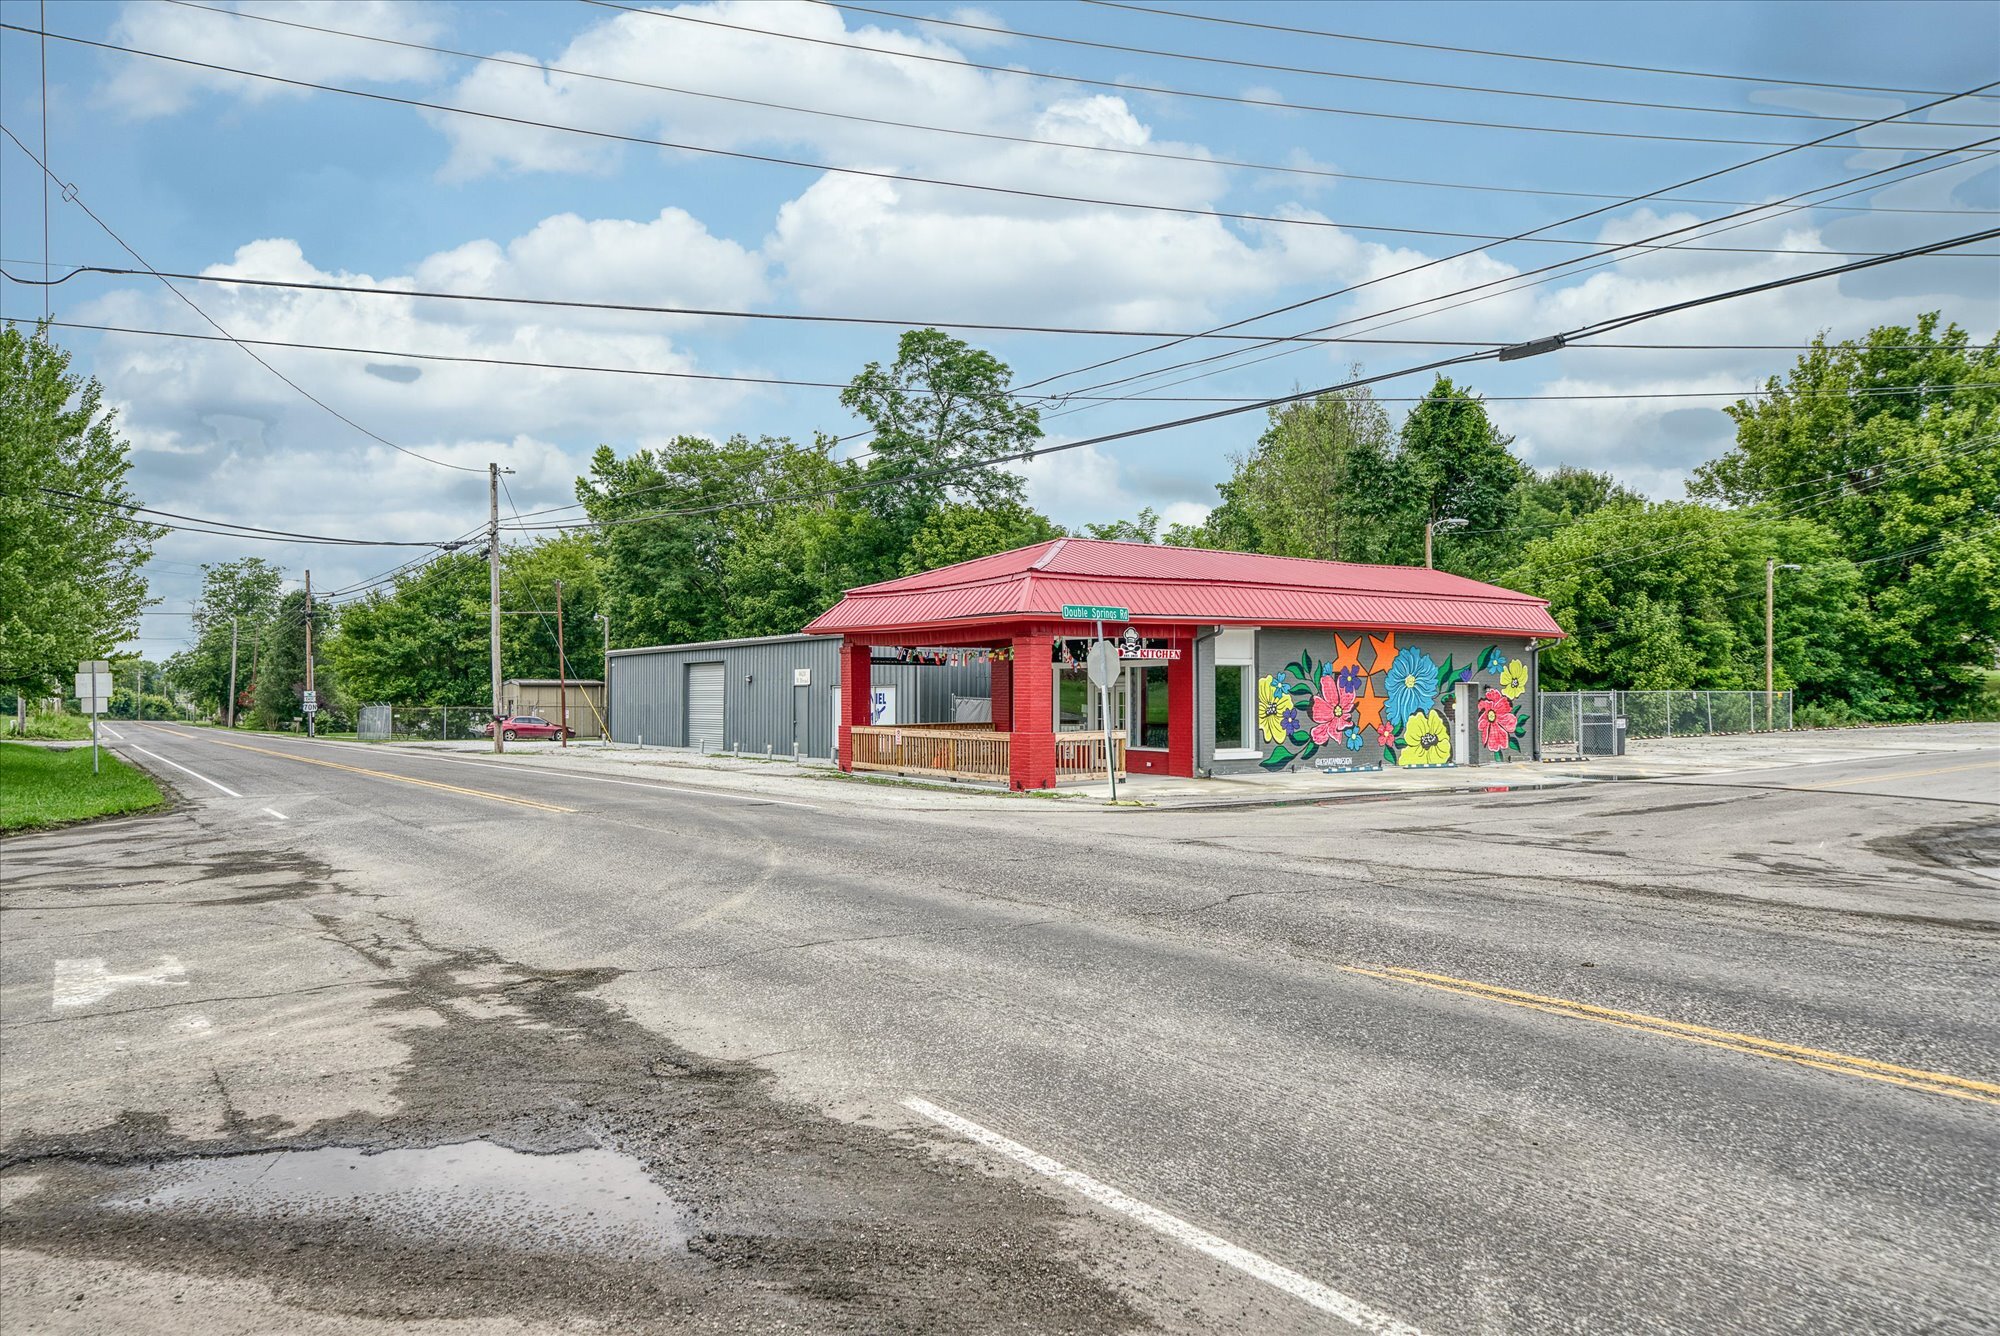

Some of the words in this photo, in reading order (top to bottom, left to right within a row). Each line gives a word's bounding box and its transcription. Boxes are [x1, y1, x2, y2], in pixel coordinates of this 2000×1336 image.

[1064, 606, 1088, 617] Double
[1091, 607, 1117, 620] Springs
[1119, 609, 1128, 620] Rd
[1140, 649, 1180, 659] KITCHEN
